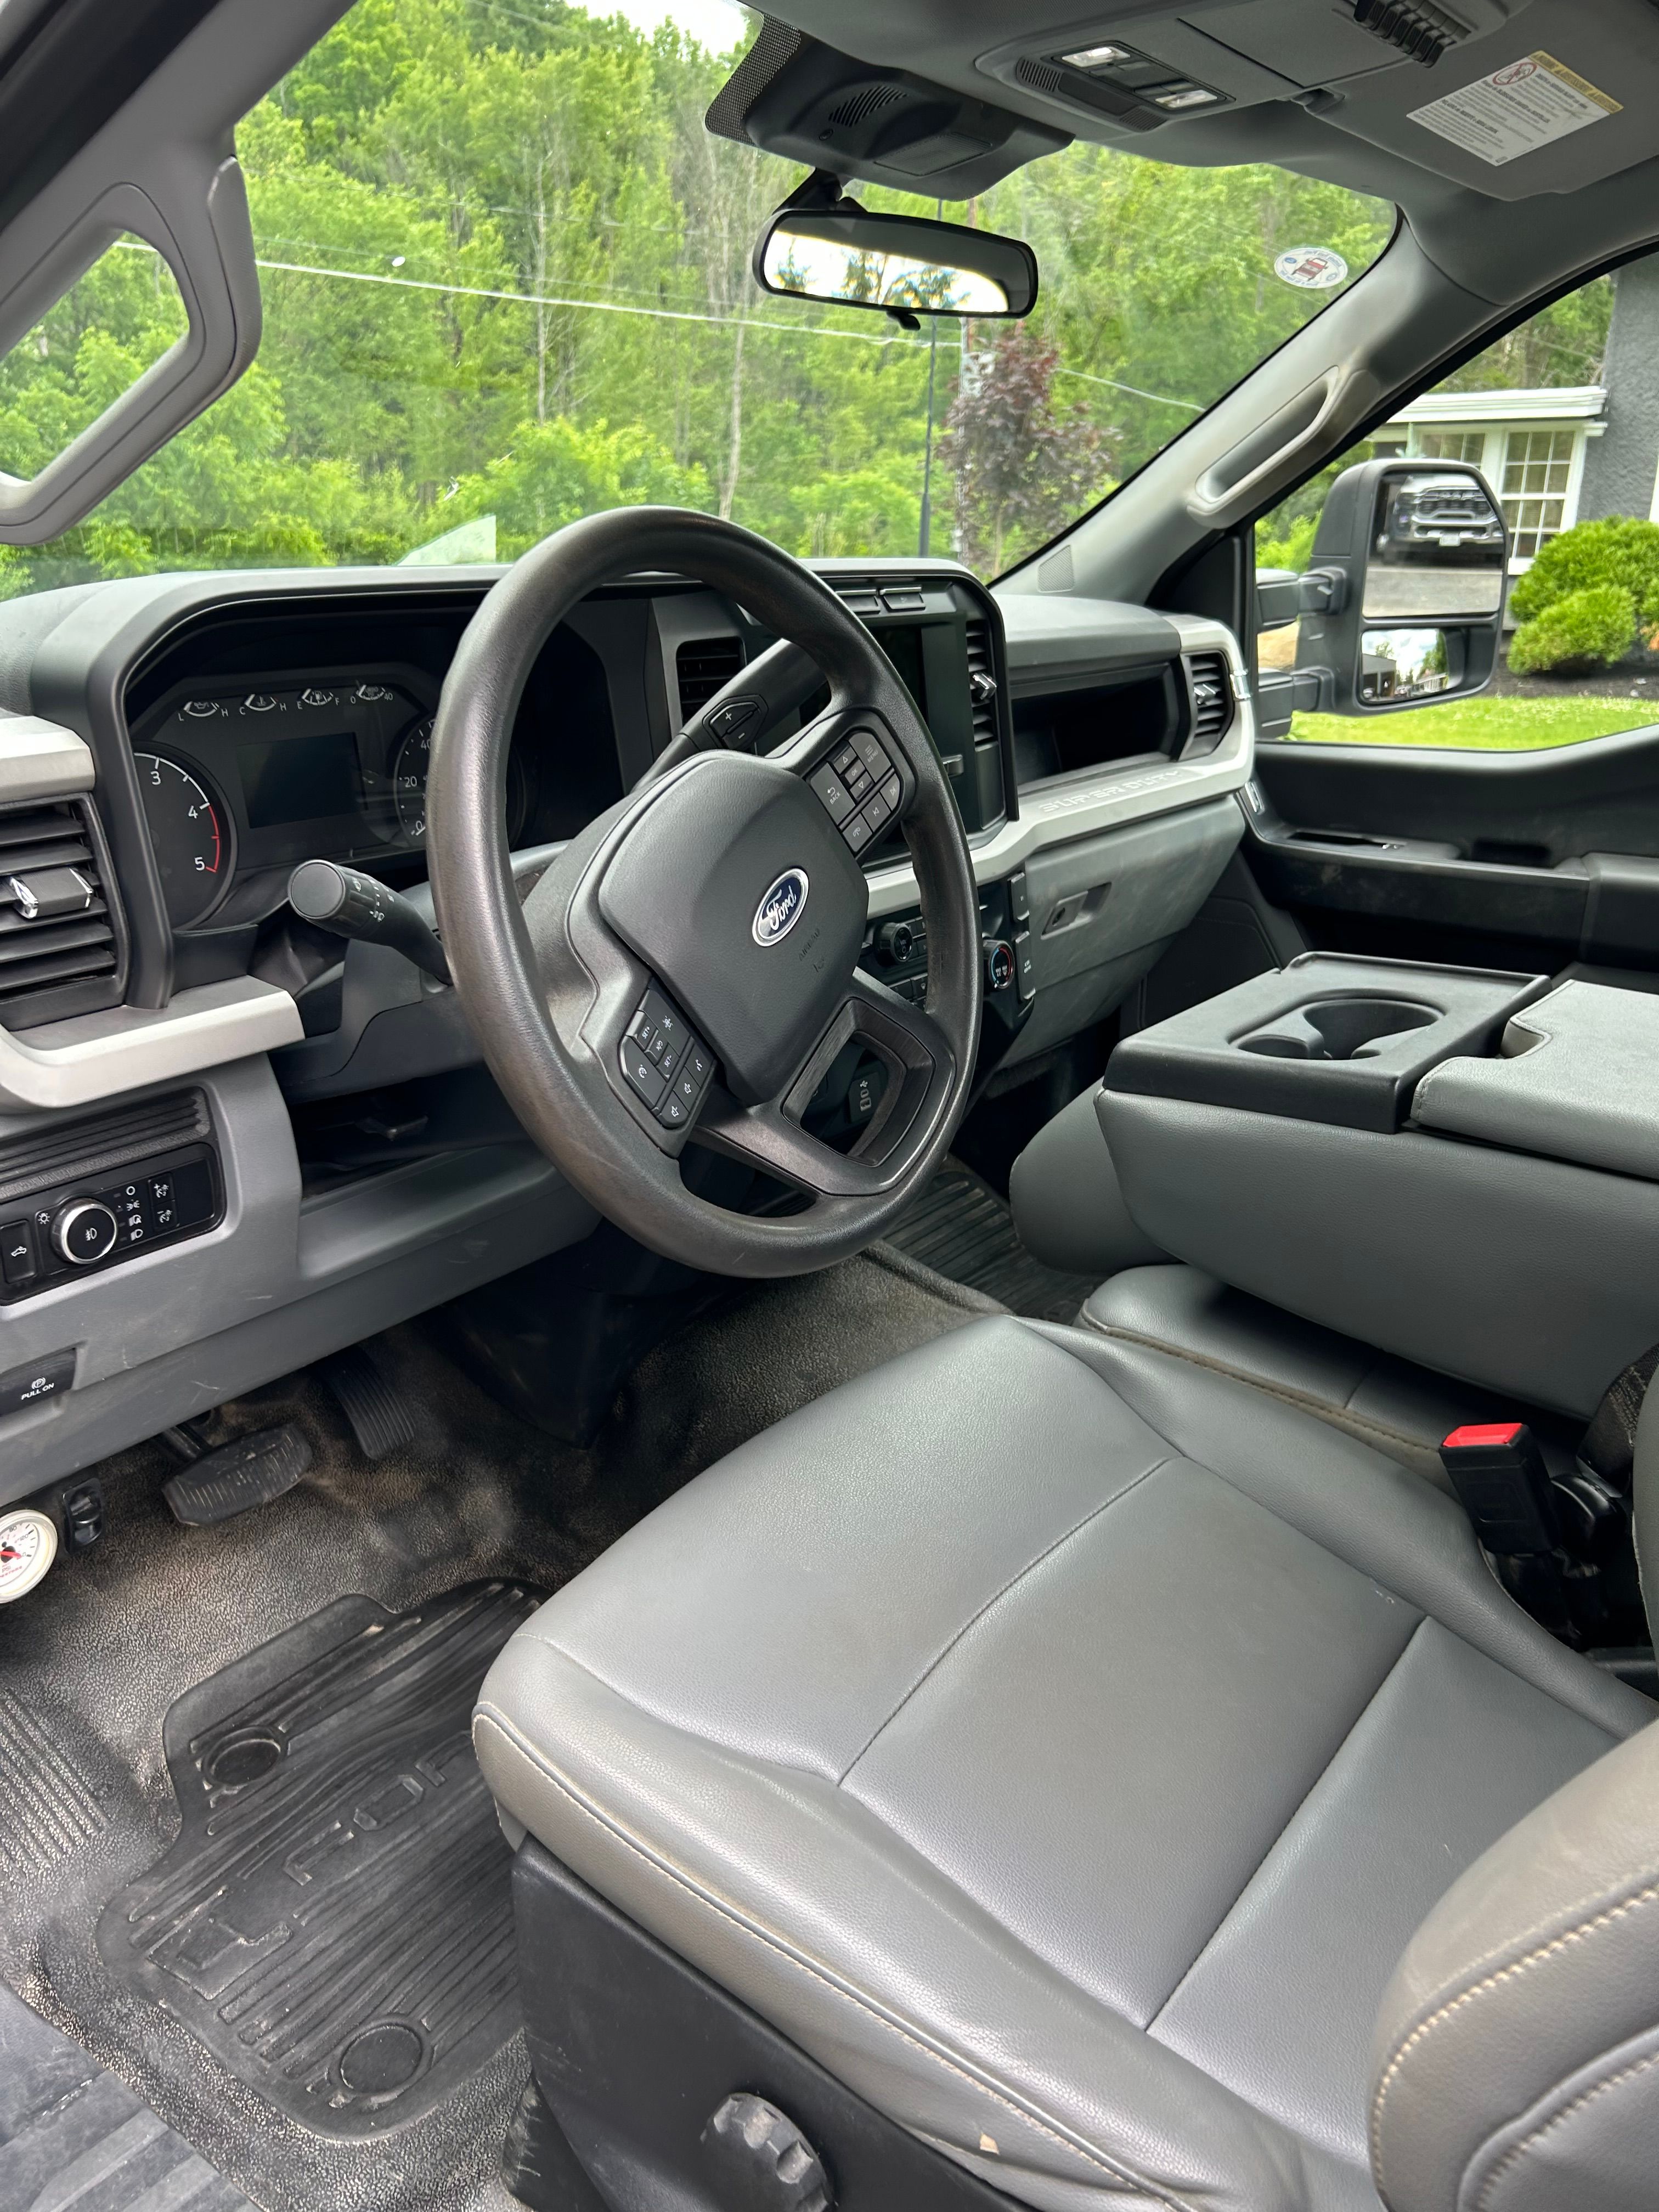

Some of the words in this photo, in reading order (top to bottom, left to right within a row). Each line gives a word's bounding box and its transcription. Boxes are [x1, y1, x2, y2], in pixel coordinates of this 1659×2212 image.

[280, 702, 287, 712] H
[297, 701, 303, 709] E
[335, 697, 340, 706] F
[178, 713, 184, 721] L
[221, 708, 229, 717] H
[239, 707, 246, 715] C
[867, 751, 878, 763] MENU
[150, 771, 161, 785] 3
[404, 776, 417, 787] 20
[1038, 786, 1125, 812] SUPER
[1122, 770, 1182, 789] DUTY
[830, 792, 841, 804] BACK
[188, 805, 198, 819] 4
[194, 856, 205, 871] 5
[766, 885, 797, 930] Ford
[21, 1389, 41, 1400] PULL
[42, 1383, 54, 1391] ON
[283, 1729, 473, 1886] FOR
